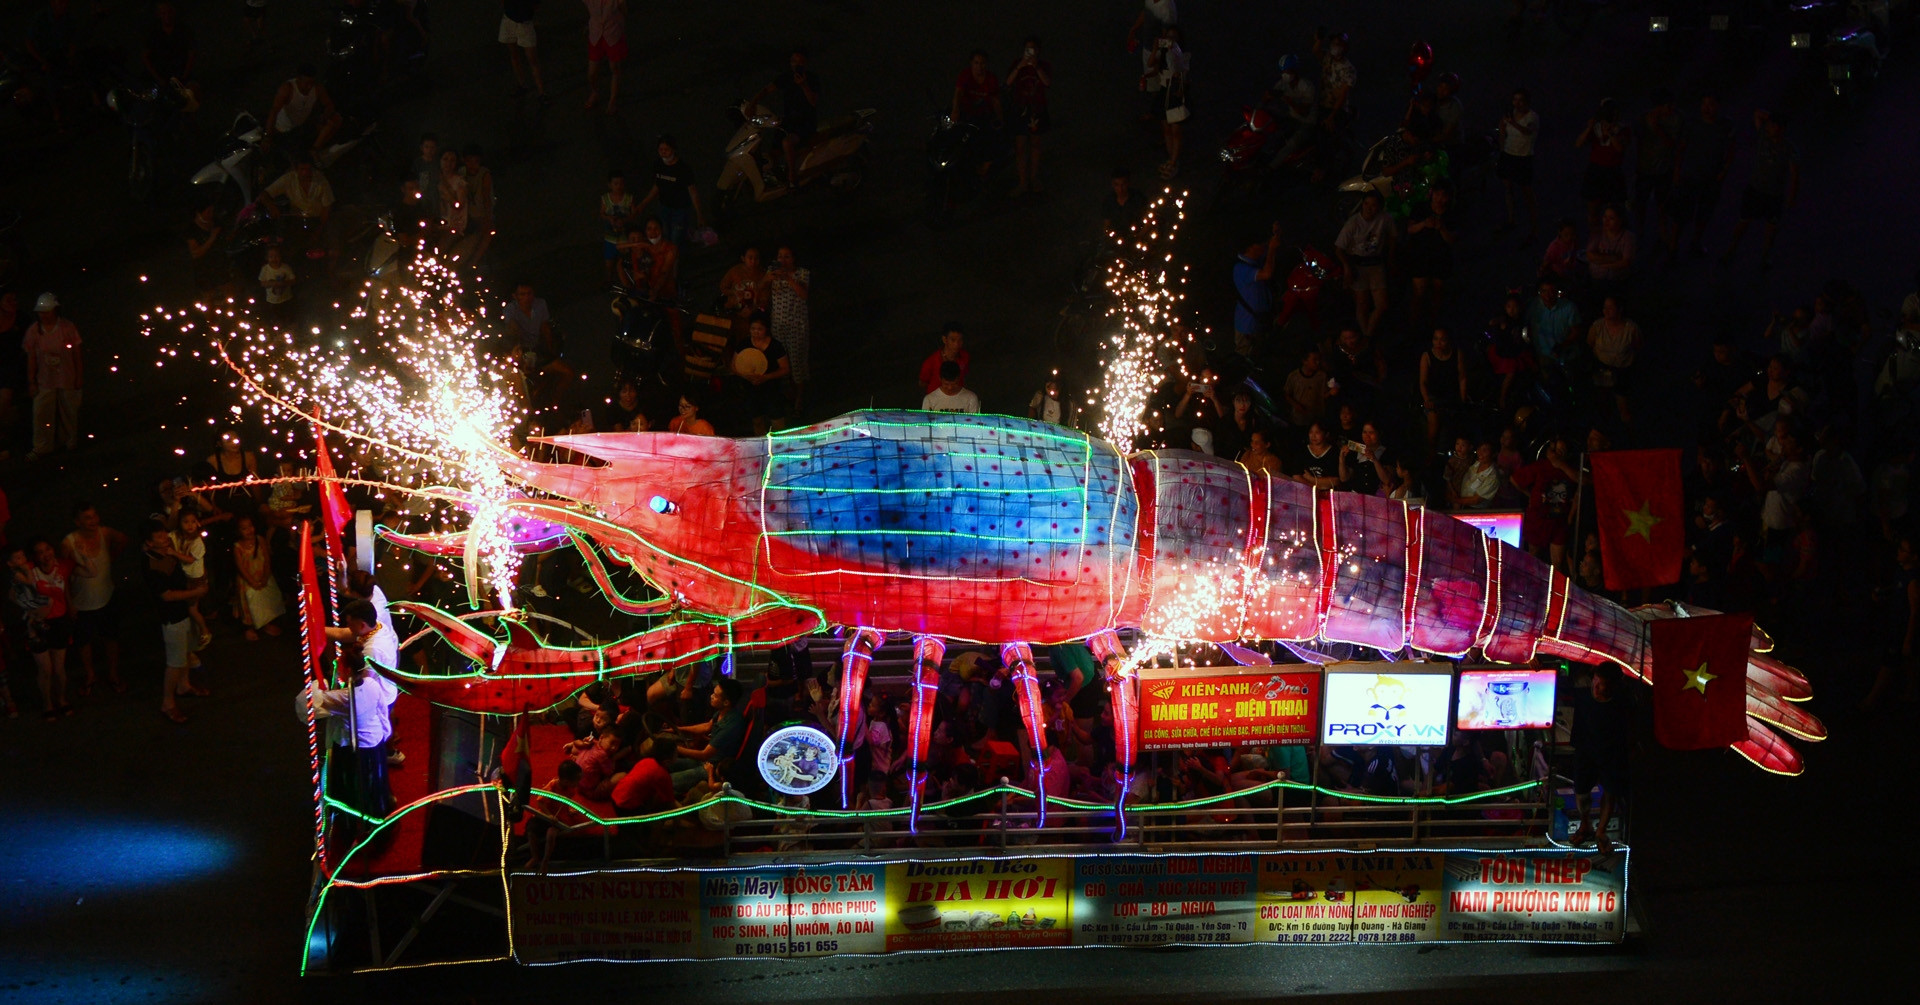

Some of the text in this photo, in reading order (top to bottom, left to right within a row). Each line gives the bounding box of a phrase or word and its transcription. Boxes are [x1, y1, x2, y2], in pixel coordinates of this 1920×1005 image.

[1182, 682, 1249, 696] KIÊN ANH
[1151, 702, 1188, 721] VÀNG
[1192, 703, 1218, 722] BẠC
[1236, 698, 1266, 721] ĐIỆN
[1270, 700, 1308, 719] THOẠI
[1144, 730, 1152, 738] GIA
[907, 861, 984, 876] Doanh
[1168, 858, 1198, 874] HOA
[1335, 857, 1394, 871] VINH
[1403, 856, 1434, 870] NA
[1480, 853, 1591, 884] TÔN THÉP
[706, 874, 739, 896] Nhà
[745, 877, 779, 898] May
[906, 876, 1058, 902] BIA HƠI
[1221, 878, 1247, 897] VIỆT
[710, 906, 733, 918] MAY
[737, 904, 752, 918] ĐO
[756, 901, 771, 917] ÂU
[812, 898, 842, 915] ĐỒNG
[847, 900, 876, 917] PHỤC
[1114, 901, 1138, 920] LỢN
[1182, 901, 1216, 918] NGỰA
[1261, 901, 1436, 921] CÁC LOẠI MÁY NÔNG LÂM NGƯ NGHIỆP
[1450, 890, 1615, 917] NAM PHƯỢNG KM 16
[713, 926, 735, 940] HỌC
[739, 925, 769, 938] SINH,
[796, 920, 832, 936] NHÓM,
[837, 919, 852, 934] ÁO
[855, 919, 874, 933] DÀI
[1217, 922, 1230, 930] Sơn
[1238, 922, 1247, 930] TQ
[1269, 923, 1284, 931] Đ/C:
[1287, 923, 1299, 931] Km
[1361, 922, 1384, 931] Quang
[1392, 921, 1402, 930] Hà
[1404, 922, 1425, 931] Giang
[1311, 933, 1325, 941] 201
[1329, 933, 1350, 941] 2222
[1358, 933, 1378, 941] 0978
[1382, 933, 1397, 941] 128
[1400, 933, 1415, 941] 868
[736, 941, 838, 954] ĐT: 0915 561 655
